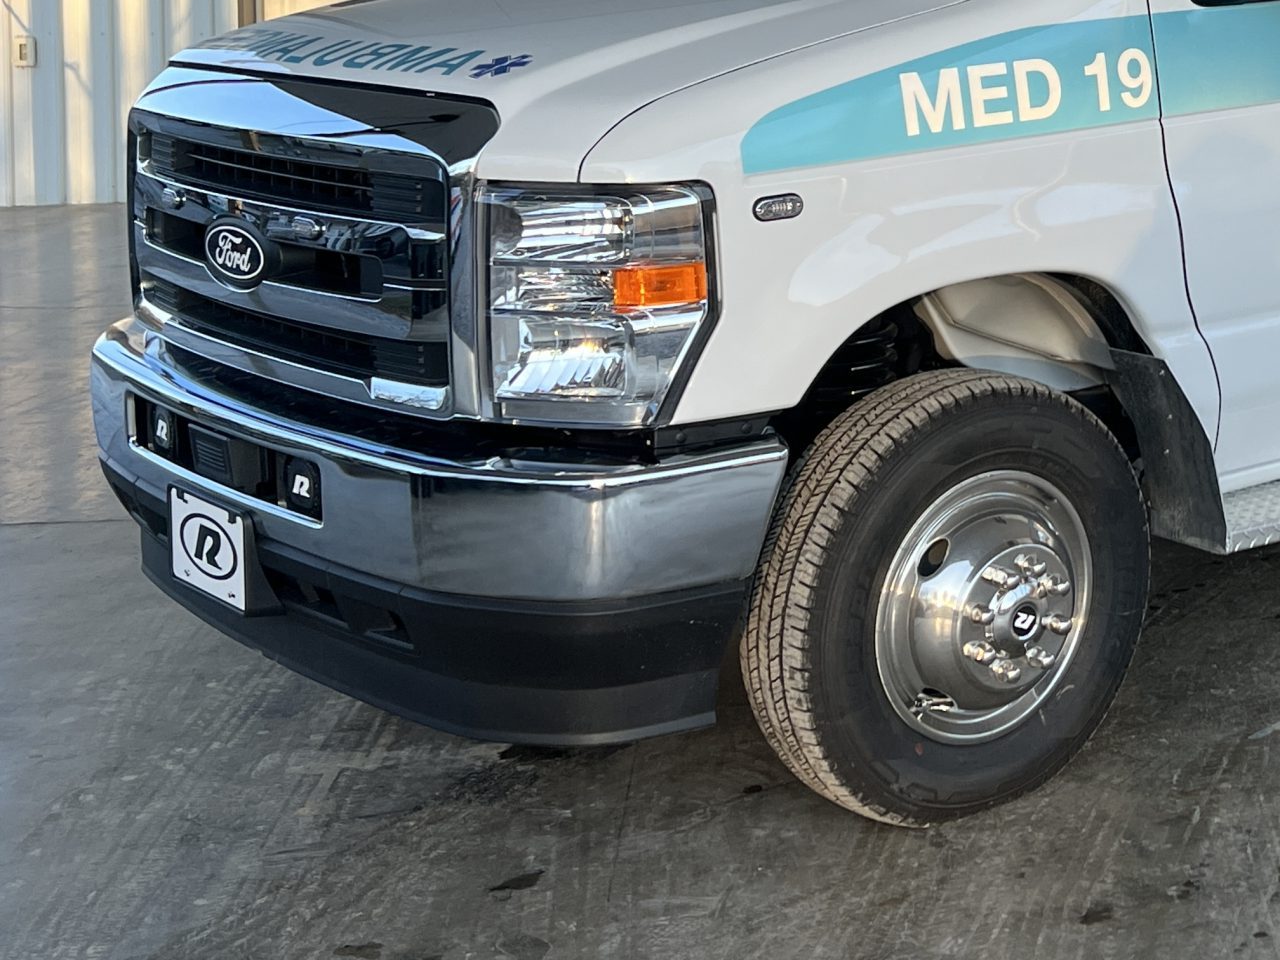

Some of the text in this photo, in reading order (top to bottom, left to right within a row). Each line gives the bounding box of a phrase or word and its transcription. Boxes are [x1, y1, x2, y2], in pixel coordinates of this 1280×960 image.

[899, 47, 1153, 137] MED 19
[215, 231, 252, 272] Ford
[292, 474, 311, 498] R
[194, 523, 223, 571] R
